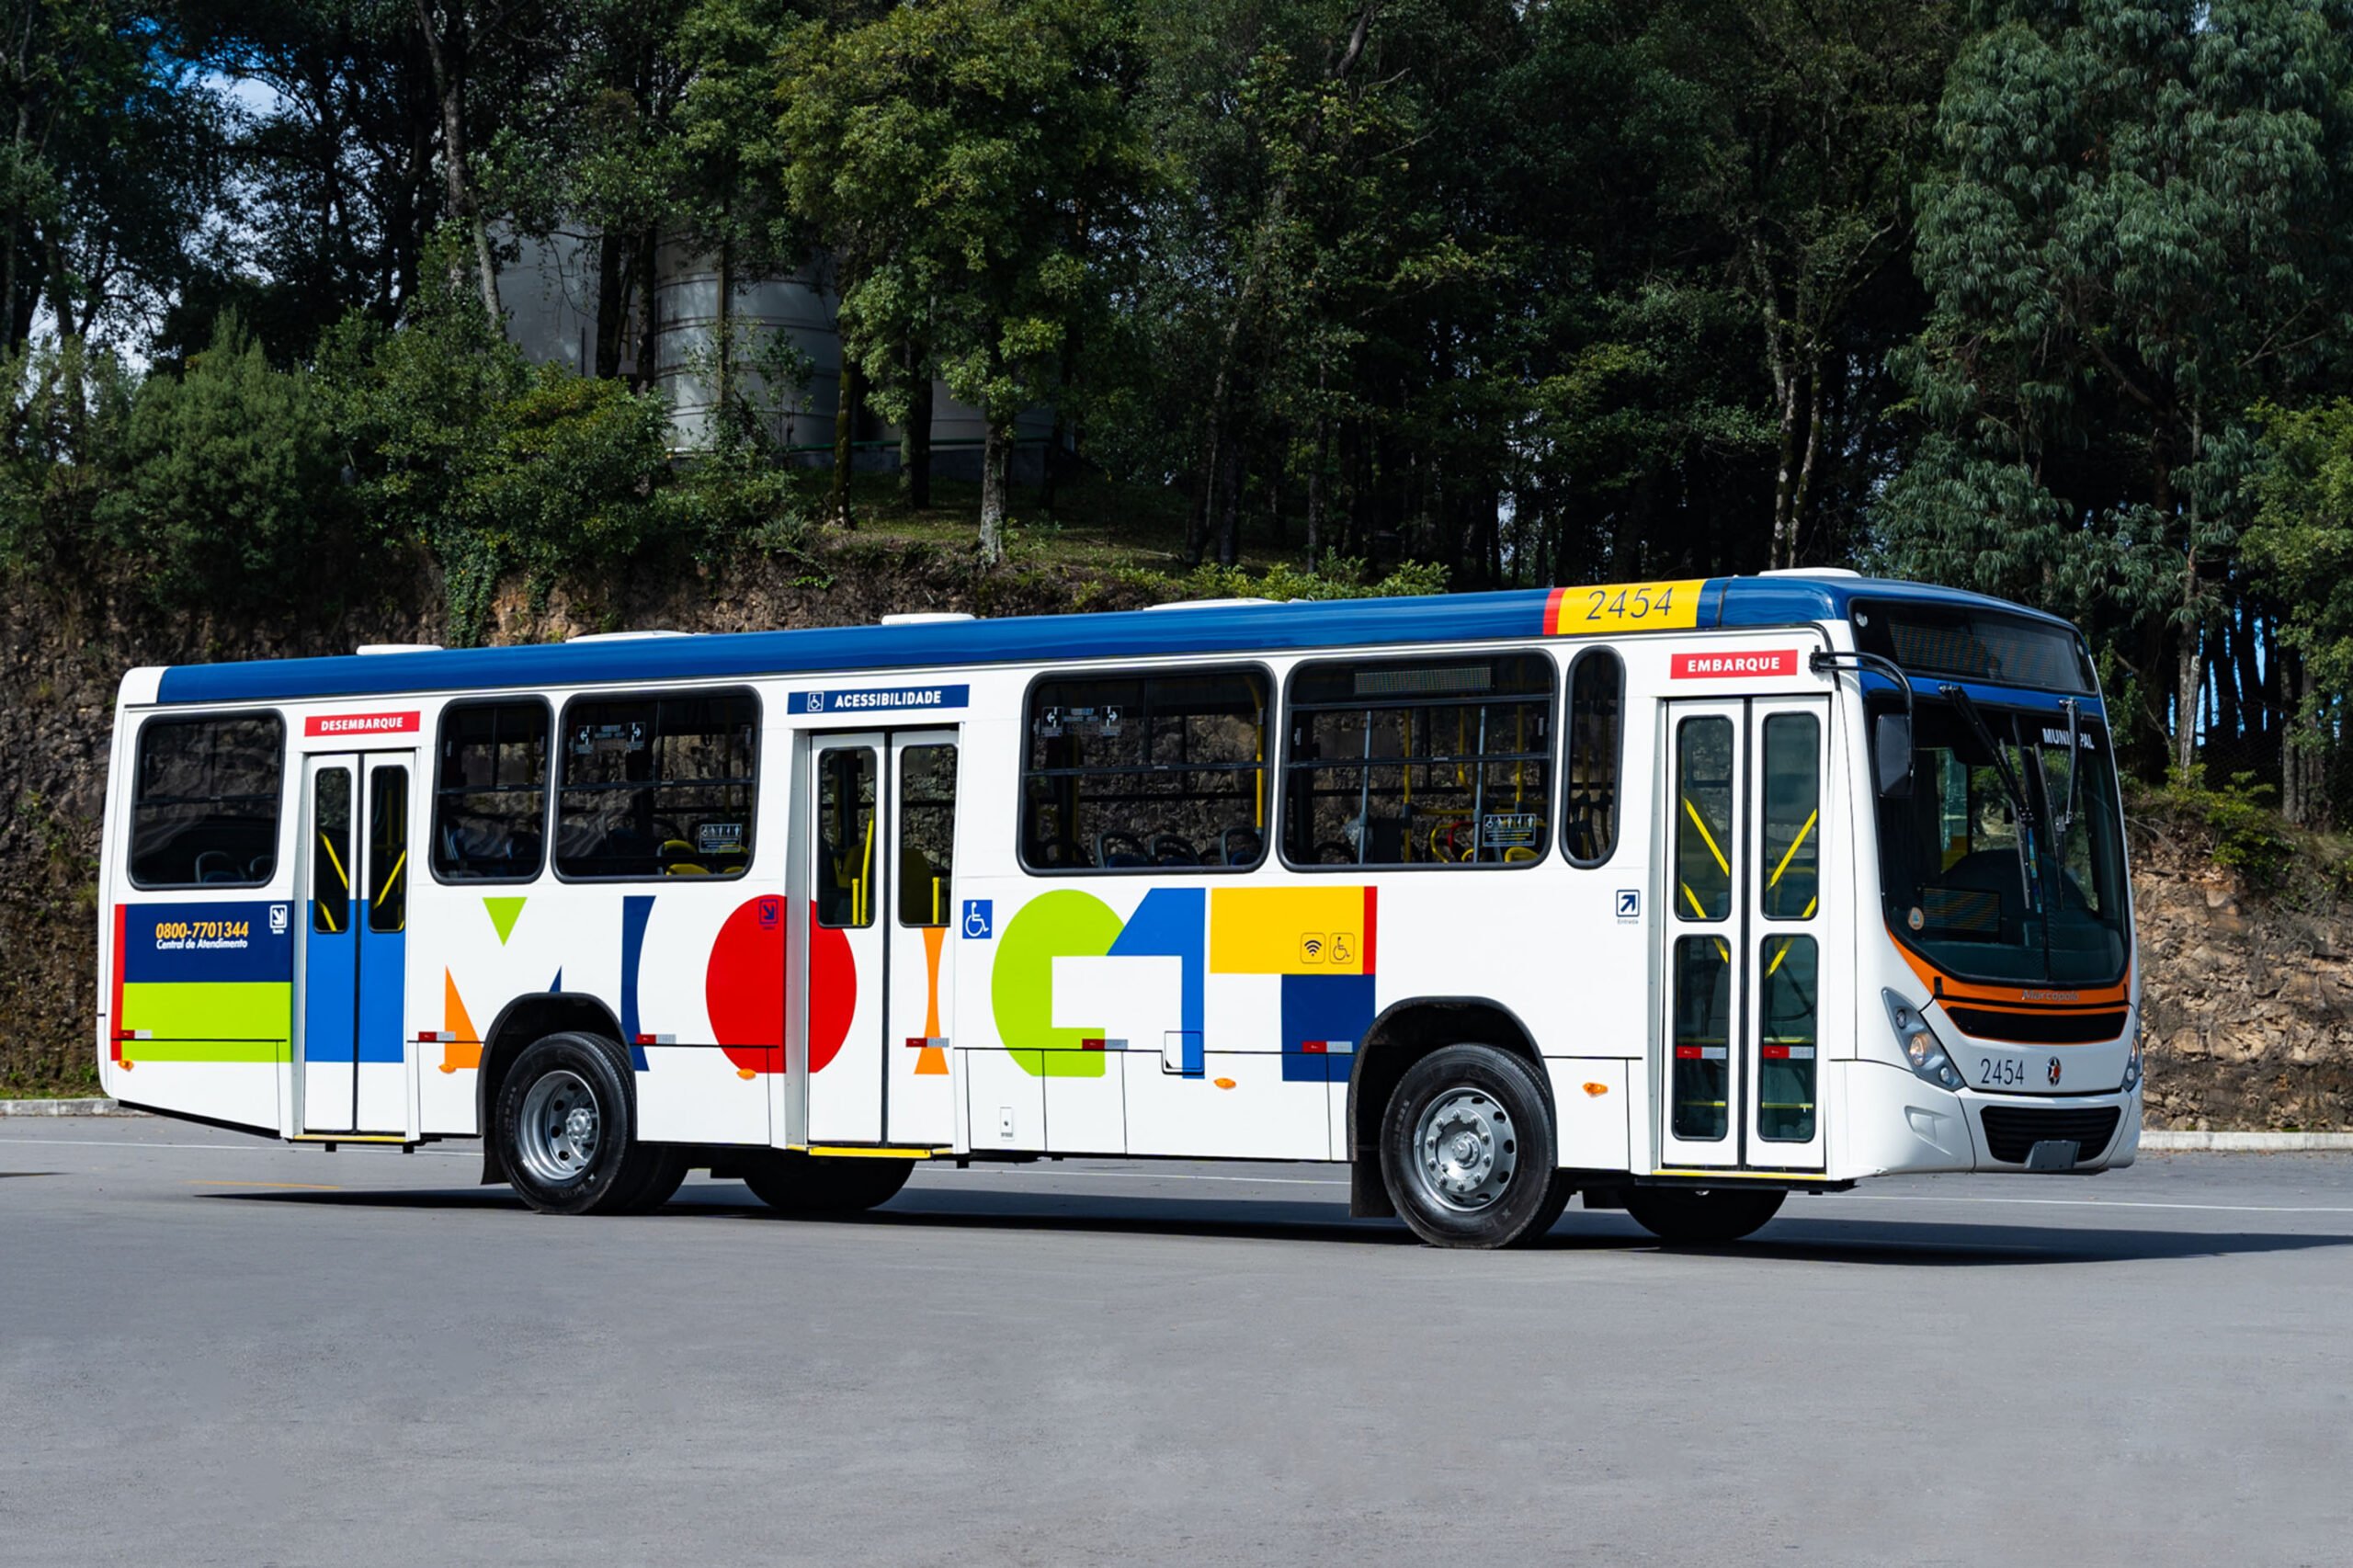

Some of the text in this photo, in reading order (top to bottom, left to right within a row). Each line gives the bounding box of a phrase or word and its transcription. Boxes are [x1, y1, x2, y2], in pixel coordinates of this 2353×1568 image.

[1586, 587, 1673, 619] 2454
[1688, 657, 1779, 672] EMBARQUE
[835, 690, 942, 708] ACESSIBILIDADE
[321, 717, 403, 731] DESEMBARQUE
[2042, 728, 2095, 749] MUNIPAL
[155, 922, 249, 938] 0800-7701344
[156, 937, 248, 949] Central de Atendimento
[1981, 1058, 2025, 1085] 2454
